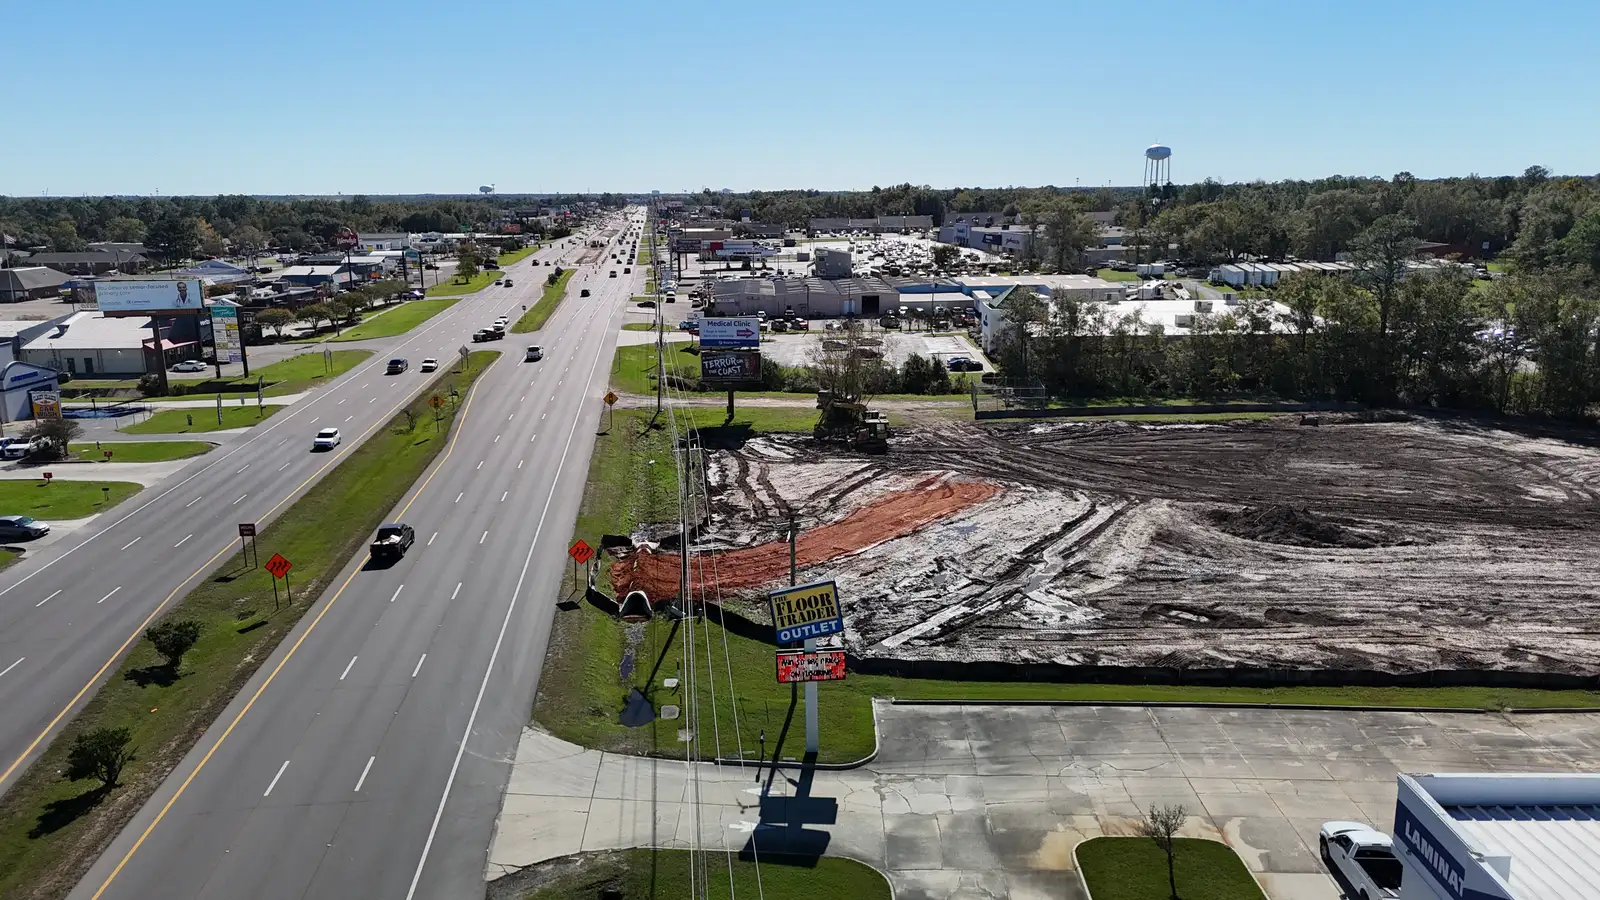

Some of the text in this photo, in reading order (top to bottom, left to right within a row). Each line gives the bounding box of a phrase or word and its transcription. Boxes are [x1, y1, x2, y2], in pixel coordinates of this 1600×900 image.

[773, 595, 788, 603] THE
[774, 592, 833, 617] FLOOR
[776, 605, 837, 628] TRADER
[780, 620, 838, 641] OUTLET
